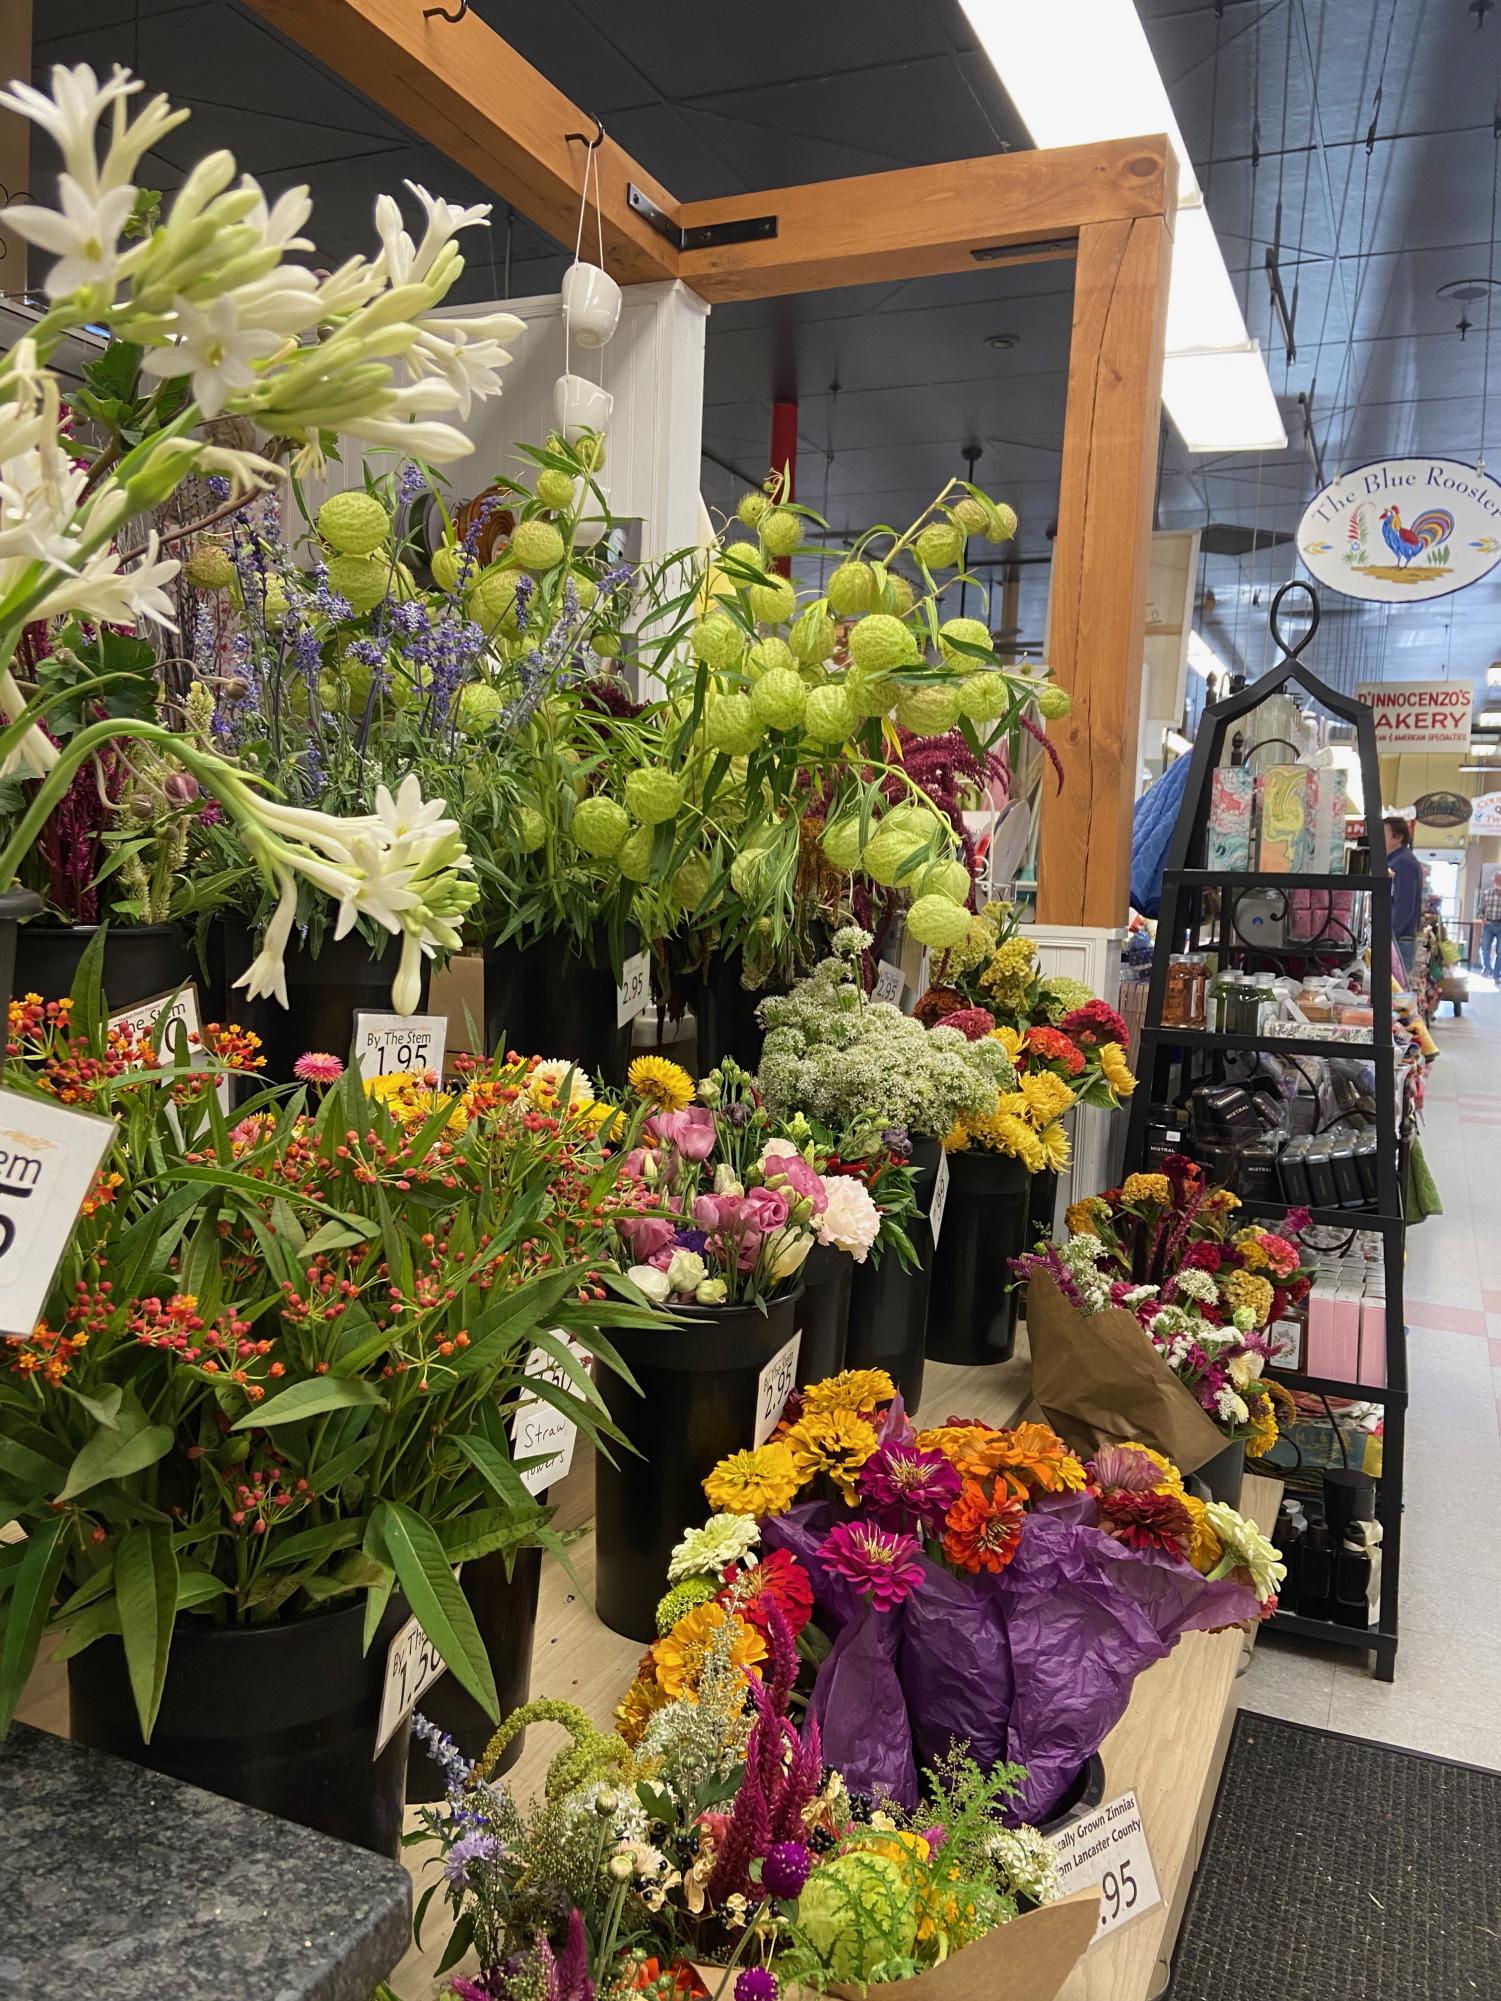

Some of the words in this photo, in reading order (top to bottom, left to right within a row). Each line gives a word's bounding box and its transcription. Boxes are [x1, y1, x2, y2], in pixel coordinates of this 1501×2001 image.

[1312, 491, 1356, 523] The
[1364, 466, 1417, 494] Blue
[1425, 466, 1501, 518] Rooster
[1375, 711, 1467, 730] AKERY
[1394, 733, 1426, 742] AMERICAN
[1427, 733, 1467, 742] SPECIALTIES
[622, 971, 644, 1006] 2.95
[876, 979, 898, 1001] 2.95
[367, 1032, 381, 1049] By
[384, 1031, 404, 1045] The
[407, 1031, 432, 1044] Stem
[377, 1044, 428, 1076] 1.95
[1225, 1104, 1250, 1120] MISTRAL
[1150, 1146, 1176, 1154] MISTRAL
[764, 1360, 793, 1420] 2.95
[524, 1419, 567, 1448] Straw
[393, 1650, 406, 1678] By
[1055, 1831, 1076, 1852] cally
[1077, 1815, 1105, 1838] Grown
[1105, 1797, 1135, 1822] Zinnias
[1058, 1862, 1073, 1878] om
[1073, 1836, 1110, 1867] Lancaster
[1111, 1819, 1142, 1843] County
